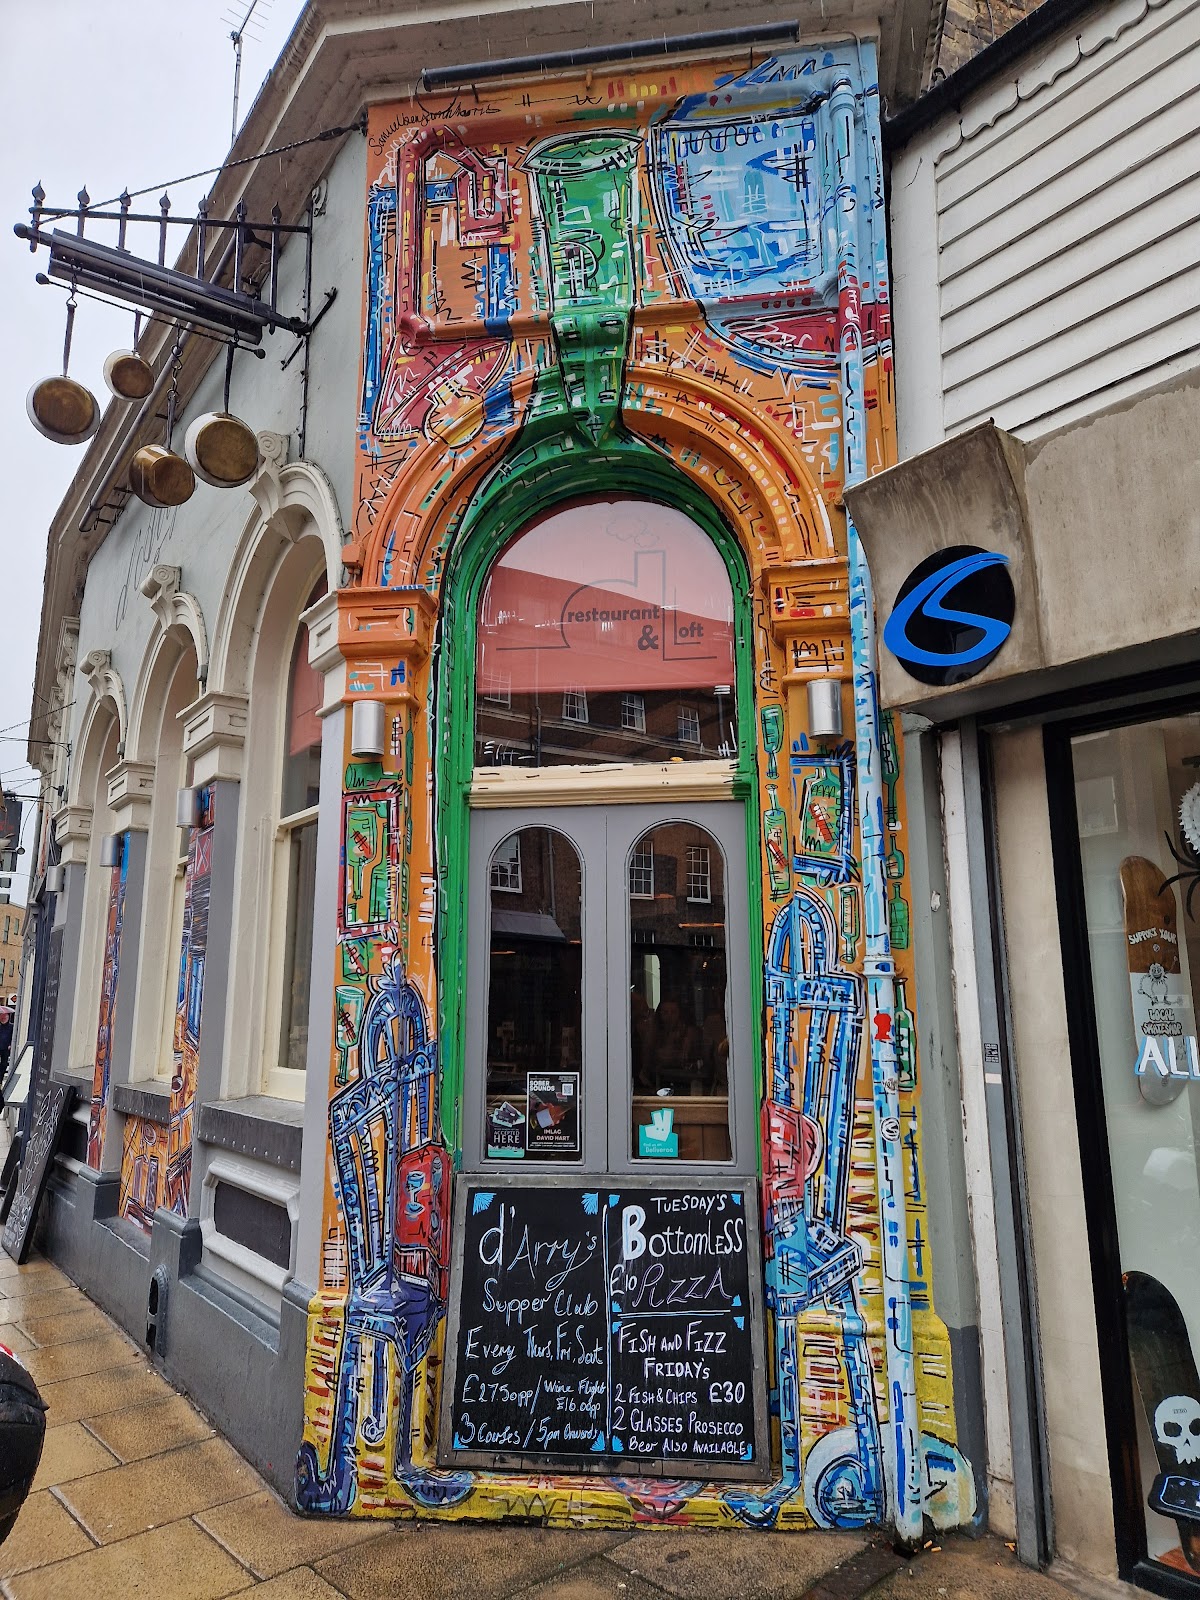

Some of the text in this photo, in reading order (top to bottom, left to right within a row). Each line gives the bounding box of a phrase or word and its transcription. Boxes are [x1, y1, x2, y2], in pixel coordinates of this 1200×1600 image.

[567, 604, 660, 622] restaurant
[637, 624, 659, 651] &
[1128, 927, 1178, 945] SUPPORT YOUR
[1148, 1008, 1176, 1022] LOCAL
[493, 1135, 520, 1144] HERE
[479, 1202, 598, 1292] d'Arry's
[610, 1263, 638, 1297] £10
[482, 1277, 599, 1327] Supper Club
[464, 1325, 517, 1376] Every
[575, 1324, 604, 1365] Sat
[618, 1322, 657, 1354] FISH
[660, 1333, 683, 1352] AND
[543, 1379, 575, 1394] Wine
[578, 1376, 607, 1404] Flight
[614, 1382, 627, 1404] 2
[708, 1381, 746, 1404] £30
[459, 1412, 476, 1443] 3
[477, 1421, 521, 1445] Courses
[535, 1415, 560, 1451] 5pm
[563, 1421, 599, 1440] Onwards
[611, 1405, 744, 1436] 2 GLASSES PROSECCO
[628, 1435, 659, 1453] Beer
[692, 1440, 747, 1455] AVAILABLE
